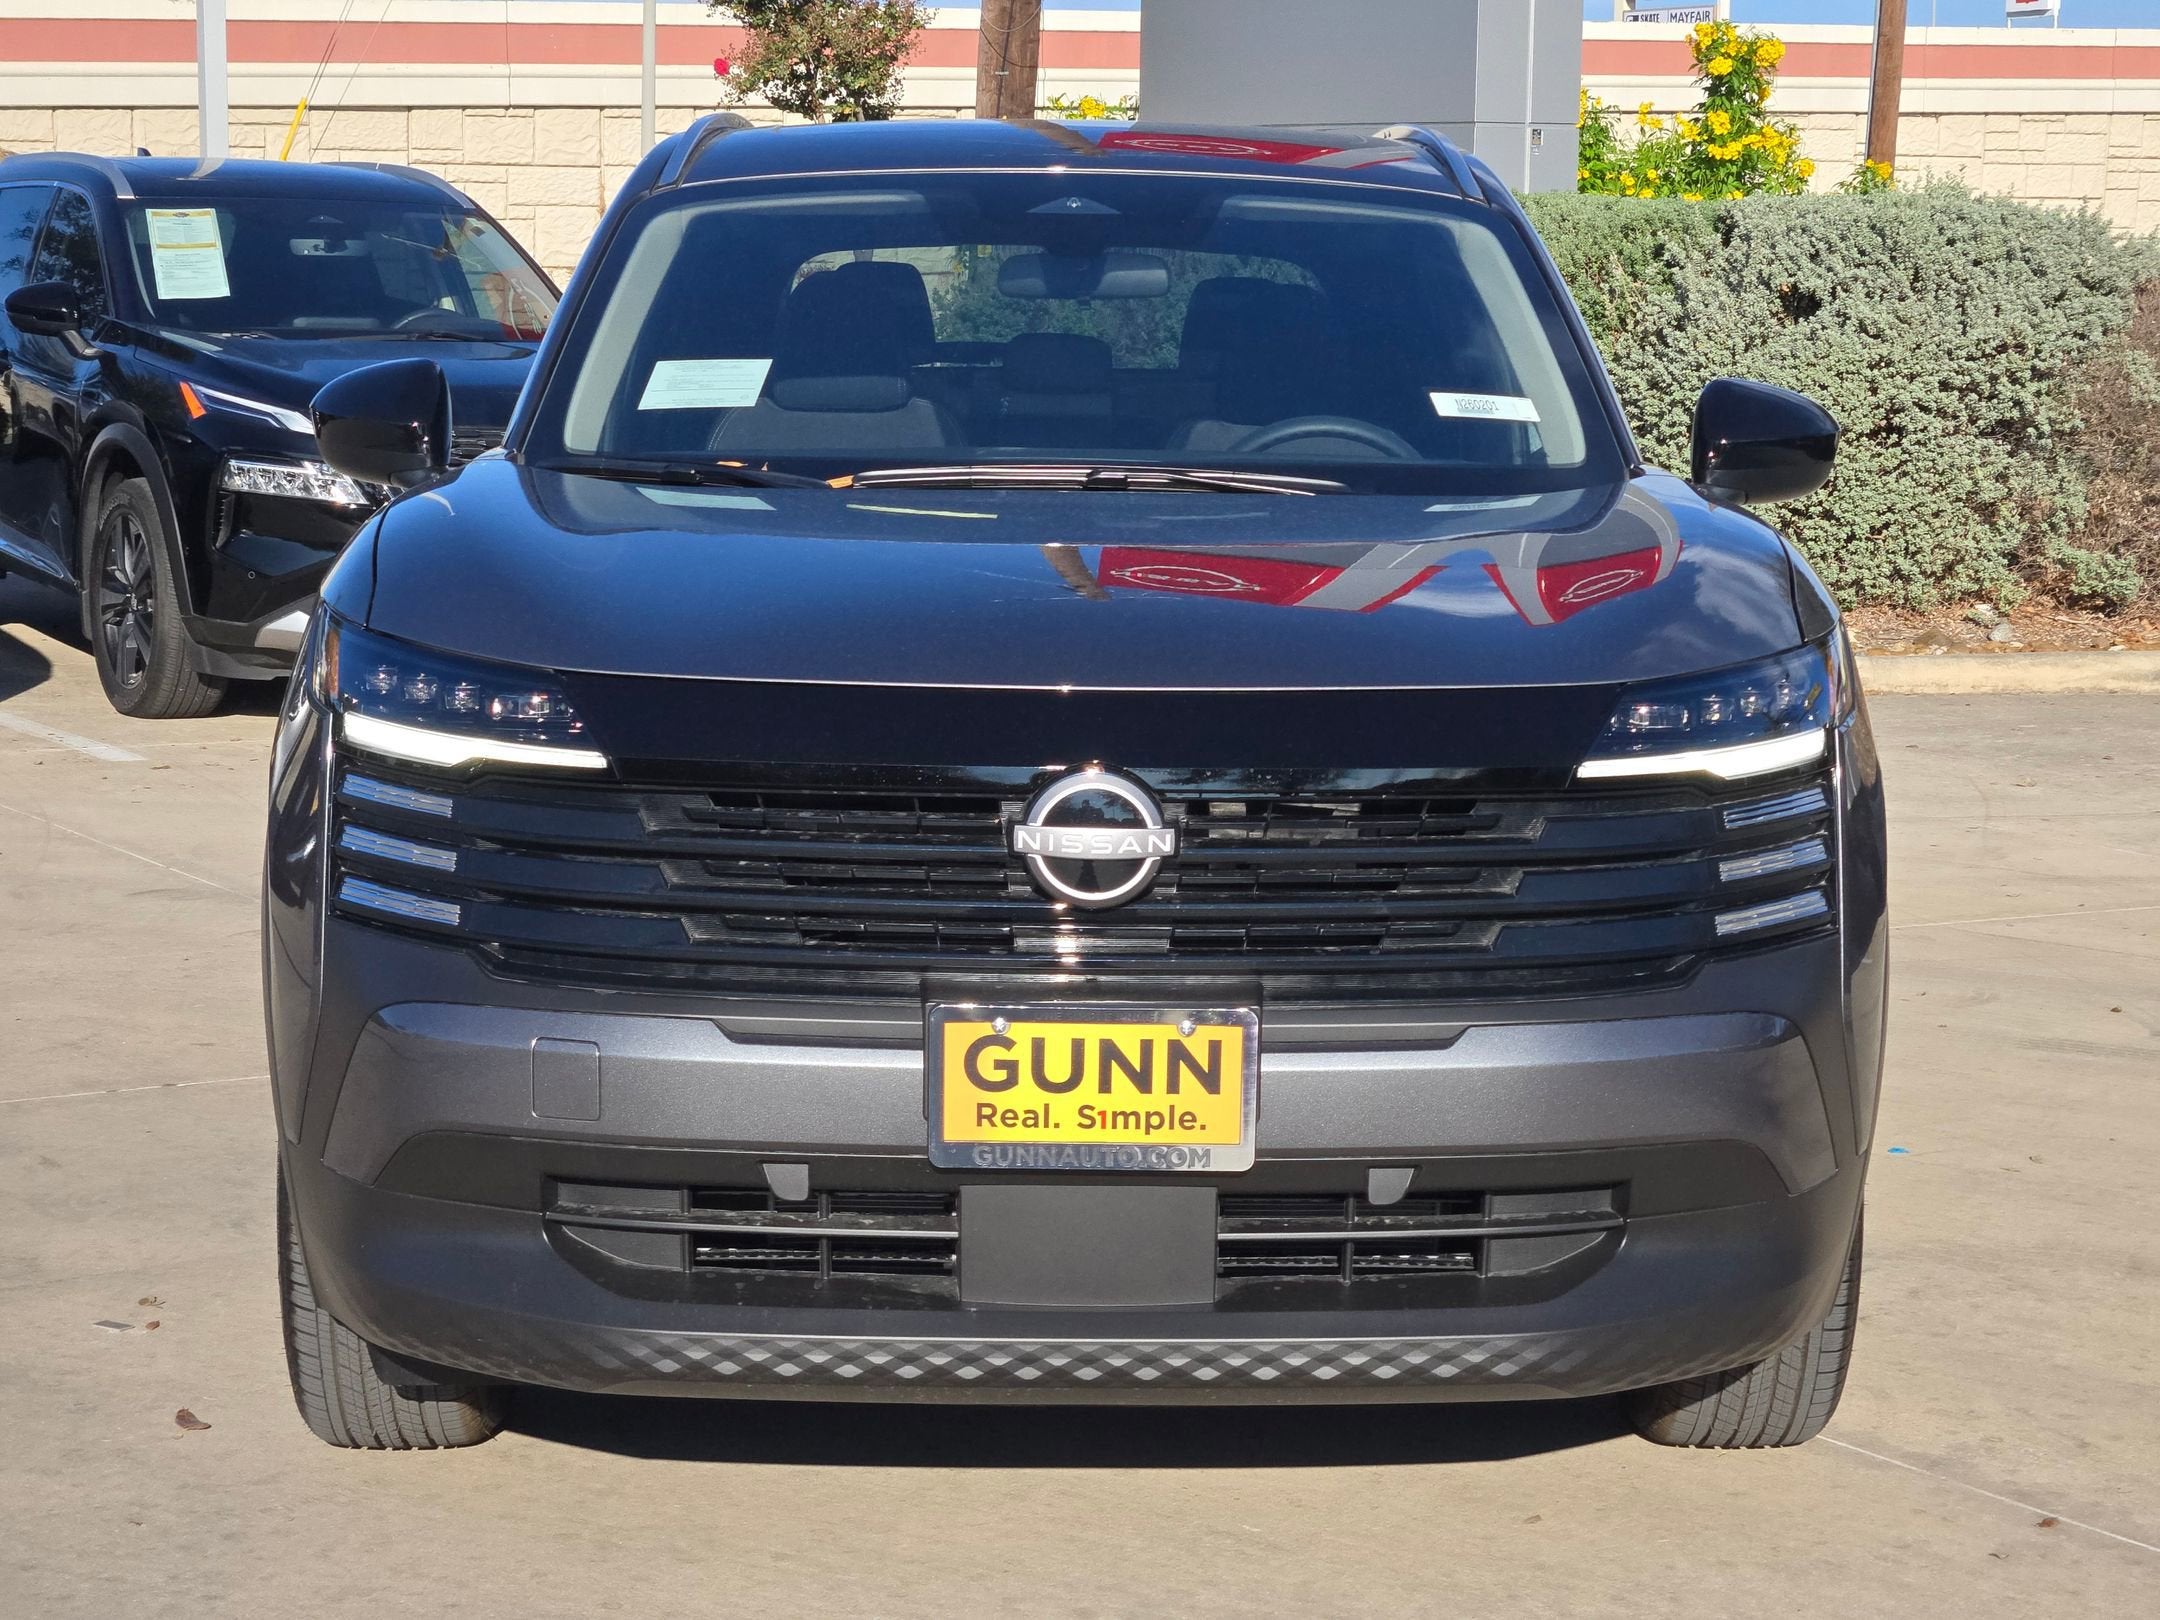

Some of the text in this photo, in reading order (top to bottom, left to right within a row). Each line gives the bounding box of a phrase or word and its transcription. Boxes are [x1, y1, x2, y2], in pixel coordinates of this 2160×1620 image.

[1669, 11, 1711, 22] MAYFAIR
[1017, 830, 1172, 855] NISSAN
[963, 1034, 1223, 1095] GUNN
[976, 1102, 1061, 1130] Real.
[972, 1145, 1211, 1168] GUNNAUTO.COM
